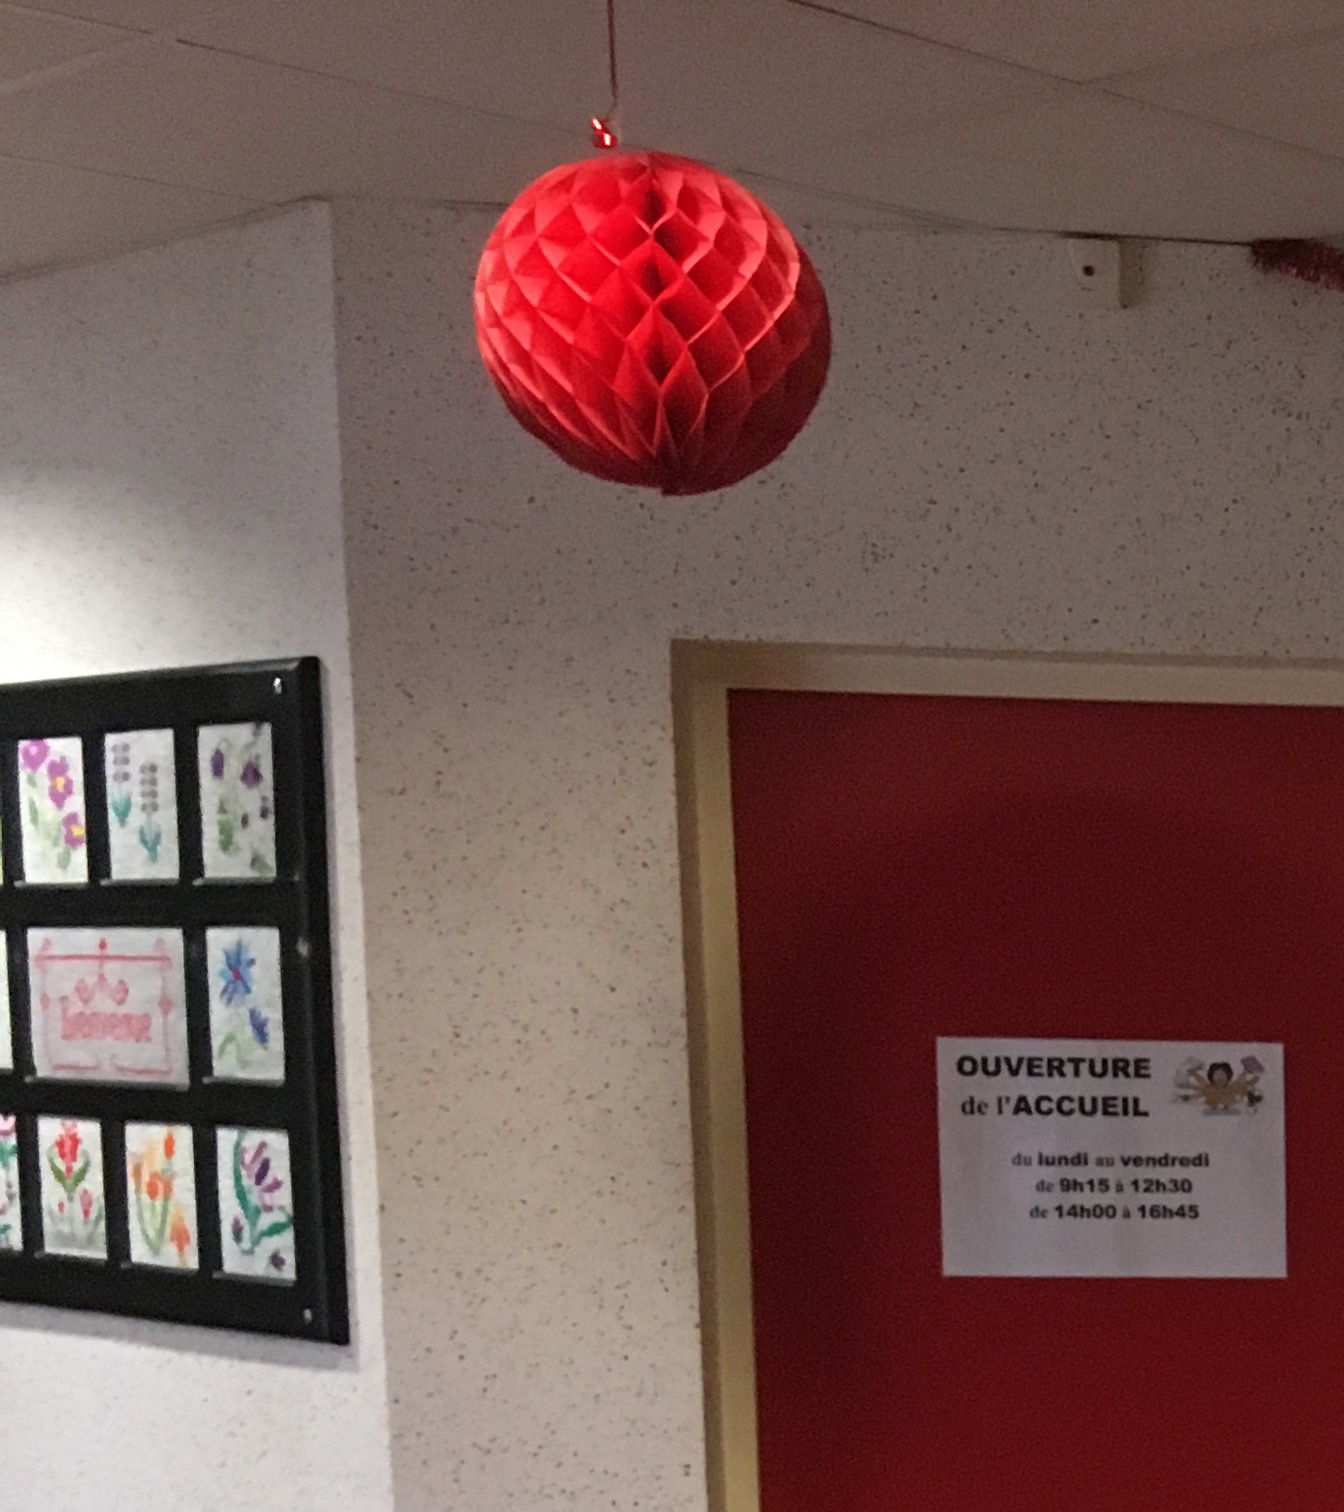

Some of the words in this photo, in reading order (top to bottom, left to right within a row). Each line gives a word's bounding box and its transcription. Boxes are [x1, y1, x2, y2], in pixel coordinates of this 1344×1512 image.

[956, 1055, 1151, 1079] OUVERTURE
[961, 1096, 989, 1116] de
[997, 1094, 1150, 1118] l'ACCUEIL
[1011, 1152, 1032, 1167] du
[1037, 1152, 1088, 1168] lundi
[1095, 1155, 1115, 1167] au
[1120, 1152, 1210, 1168] vendredi
[1035, 1179, 1054, 1193] de
[1059, 1178, 1110, 1193] 9h15
[1115, 1179, 1124, 1193] à
[1131, 1178, 1192, 1193] 12h30
[1029, 1205, 1049, 1219] de
[1054, 1204, 1117, 1220] 14h00
[1122, 1204, 1131, 1219] à
[1137, 1204, 1200, 1220] 16h45
